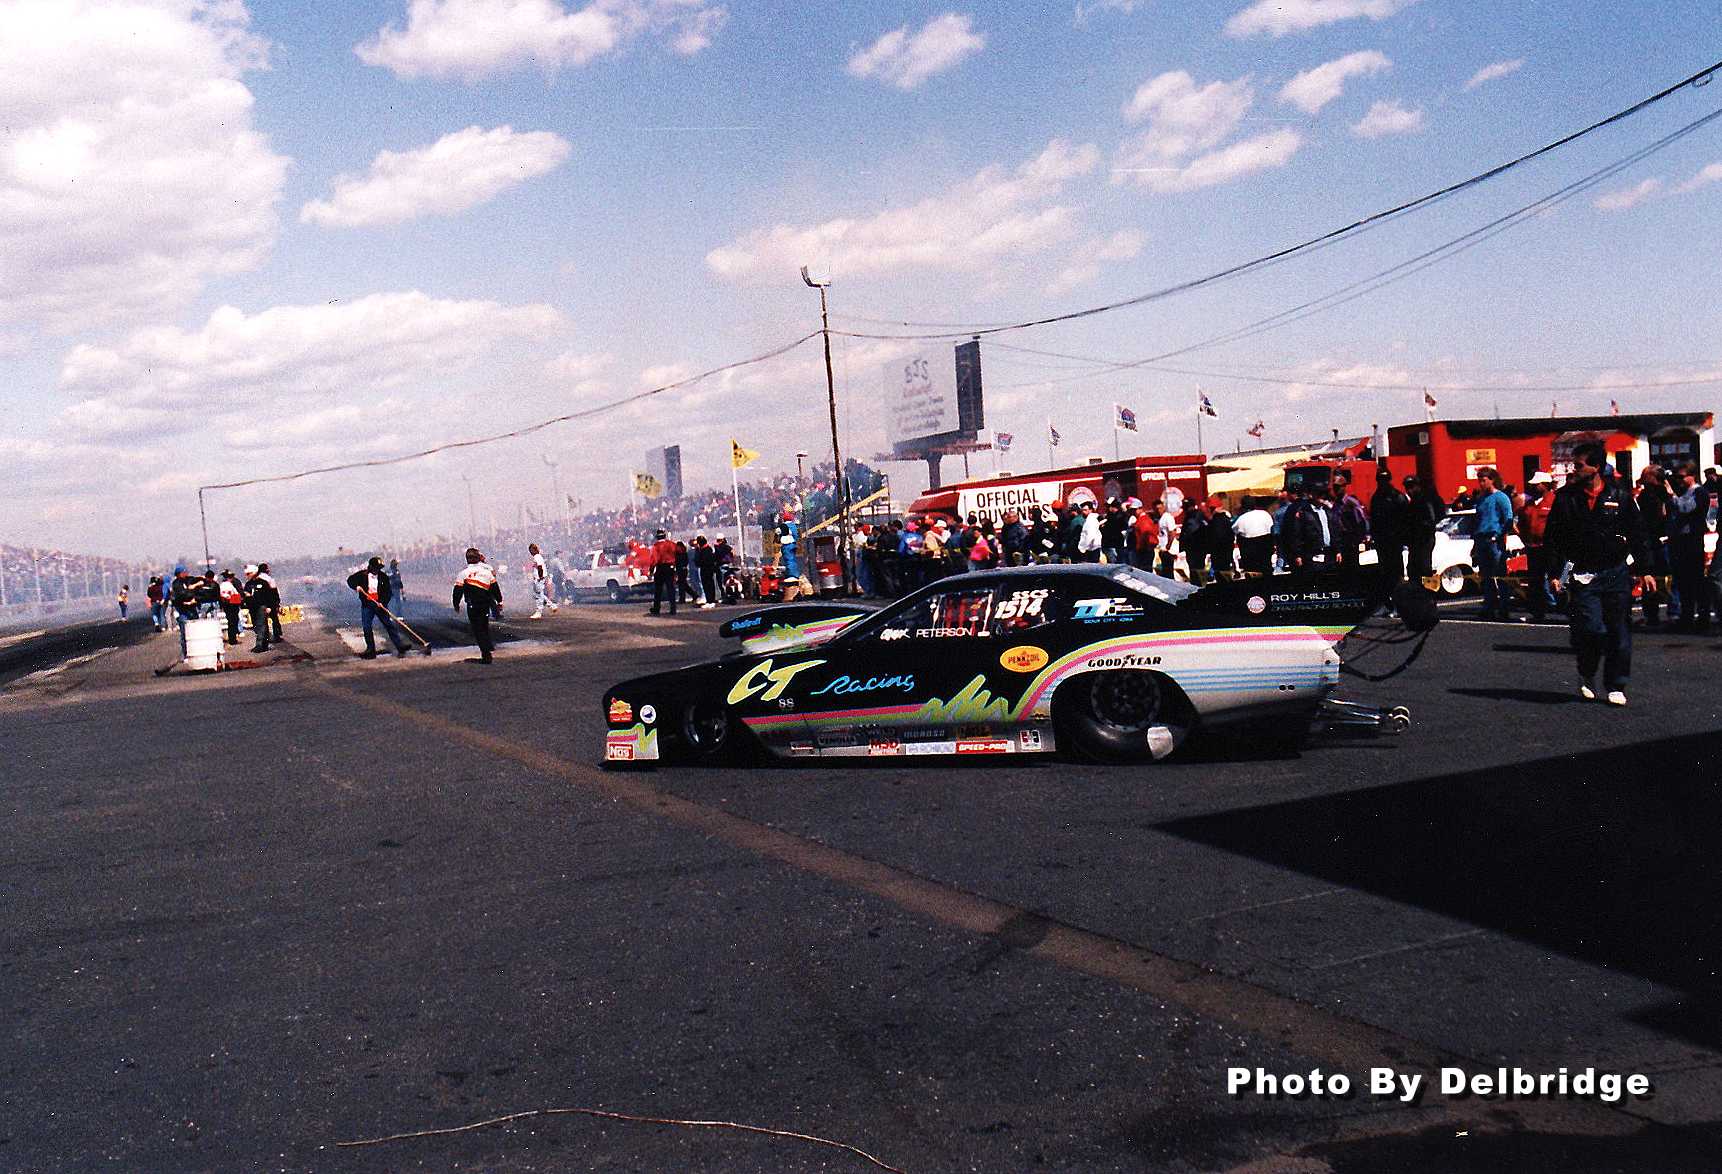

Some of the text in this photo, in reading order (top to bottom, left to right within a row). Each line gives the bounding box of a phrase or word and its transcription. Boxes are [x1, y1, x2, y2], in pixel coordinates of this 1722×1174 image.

[976, 489, 1040, 508] OFFICIAL
[1270, 594, 1298, 602] ROY
[994, 598, 1043, 619] 1514
[916, 627, 973, 638] PETERSON
[1087, 655, 1162, 668] GOODYEAR
[727, 658, 828, 705] CT
[811, 673, 915, 697] Racing
